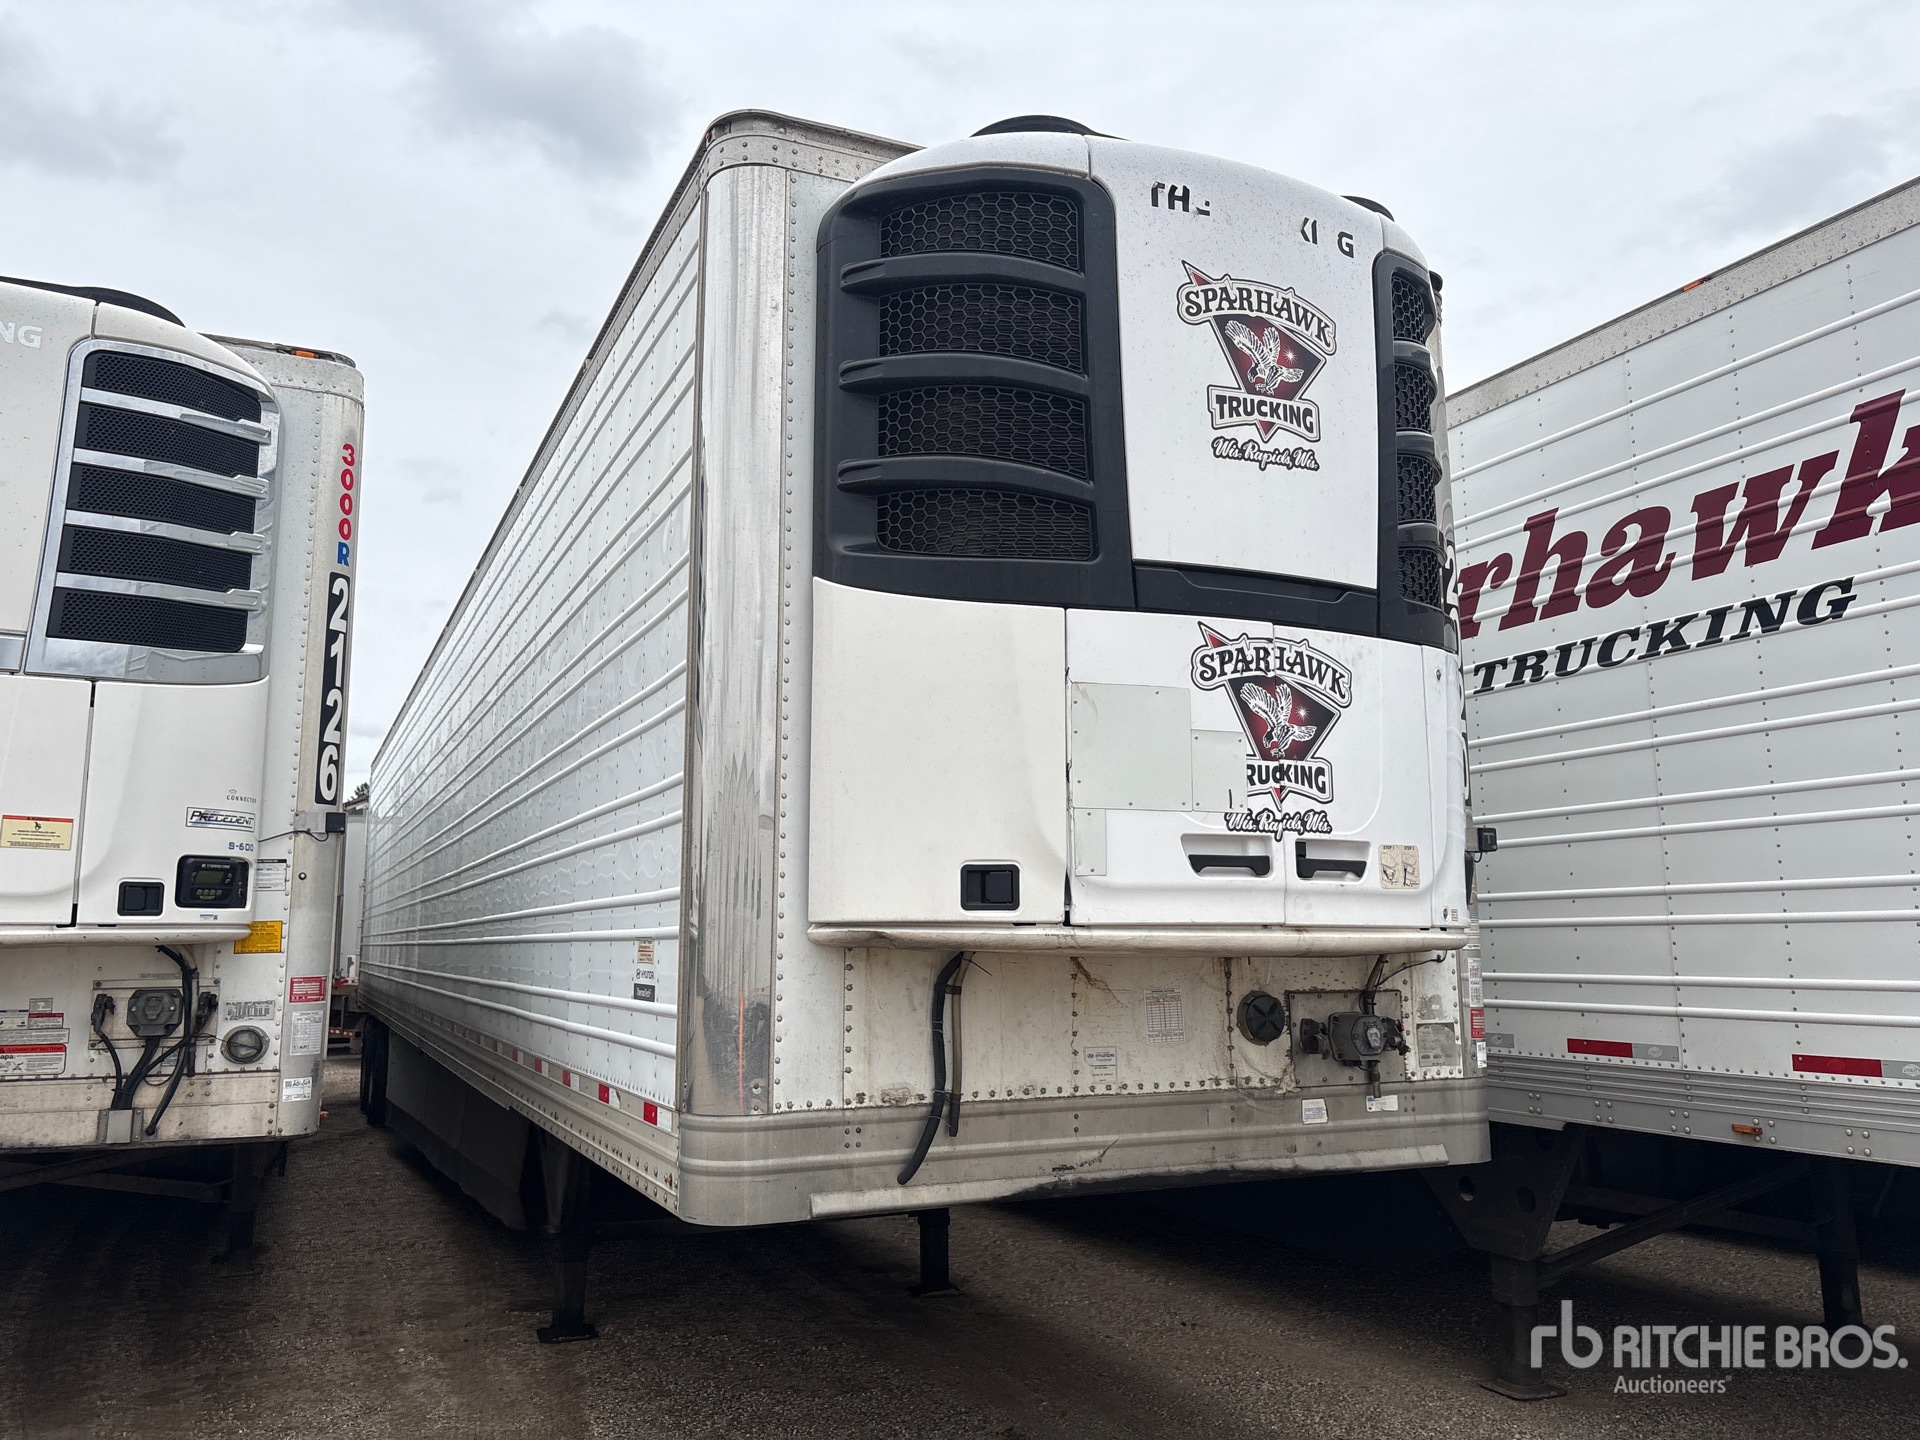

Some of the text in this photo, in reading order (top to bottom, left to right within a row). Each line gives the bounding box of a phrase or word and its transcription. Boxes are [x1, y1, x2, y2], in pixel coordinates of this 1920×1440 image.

[1185, 286, 1332, 348] SPARHAWK
[1215, 394, 1314, 434] TRUCKING
[1213, 437, 1319, 471] Wis. Rapids, Wis.
[337, 443, 355, 566] 3000R
[1472, 576, 1858, 695] TRUCKING
[319, 577, 349, 801] 2126
[1199, 645, 1346, 699] SPARHAWK
[1247, 763, 1327, 794] RUCKING
[190, 810, 253, 825] PRECEDENT
[1304, 809, 1332, 834] Wis.
[228, 842, 255, 852] S-600
